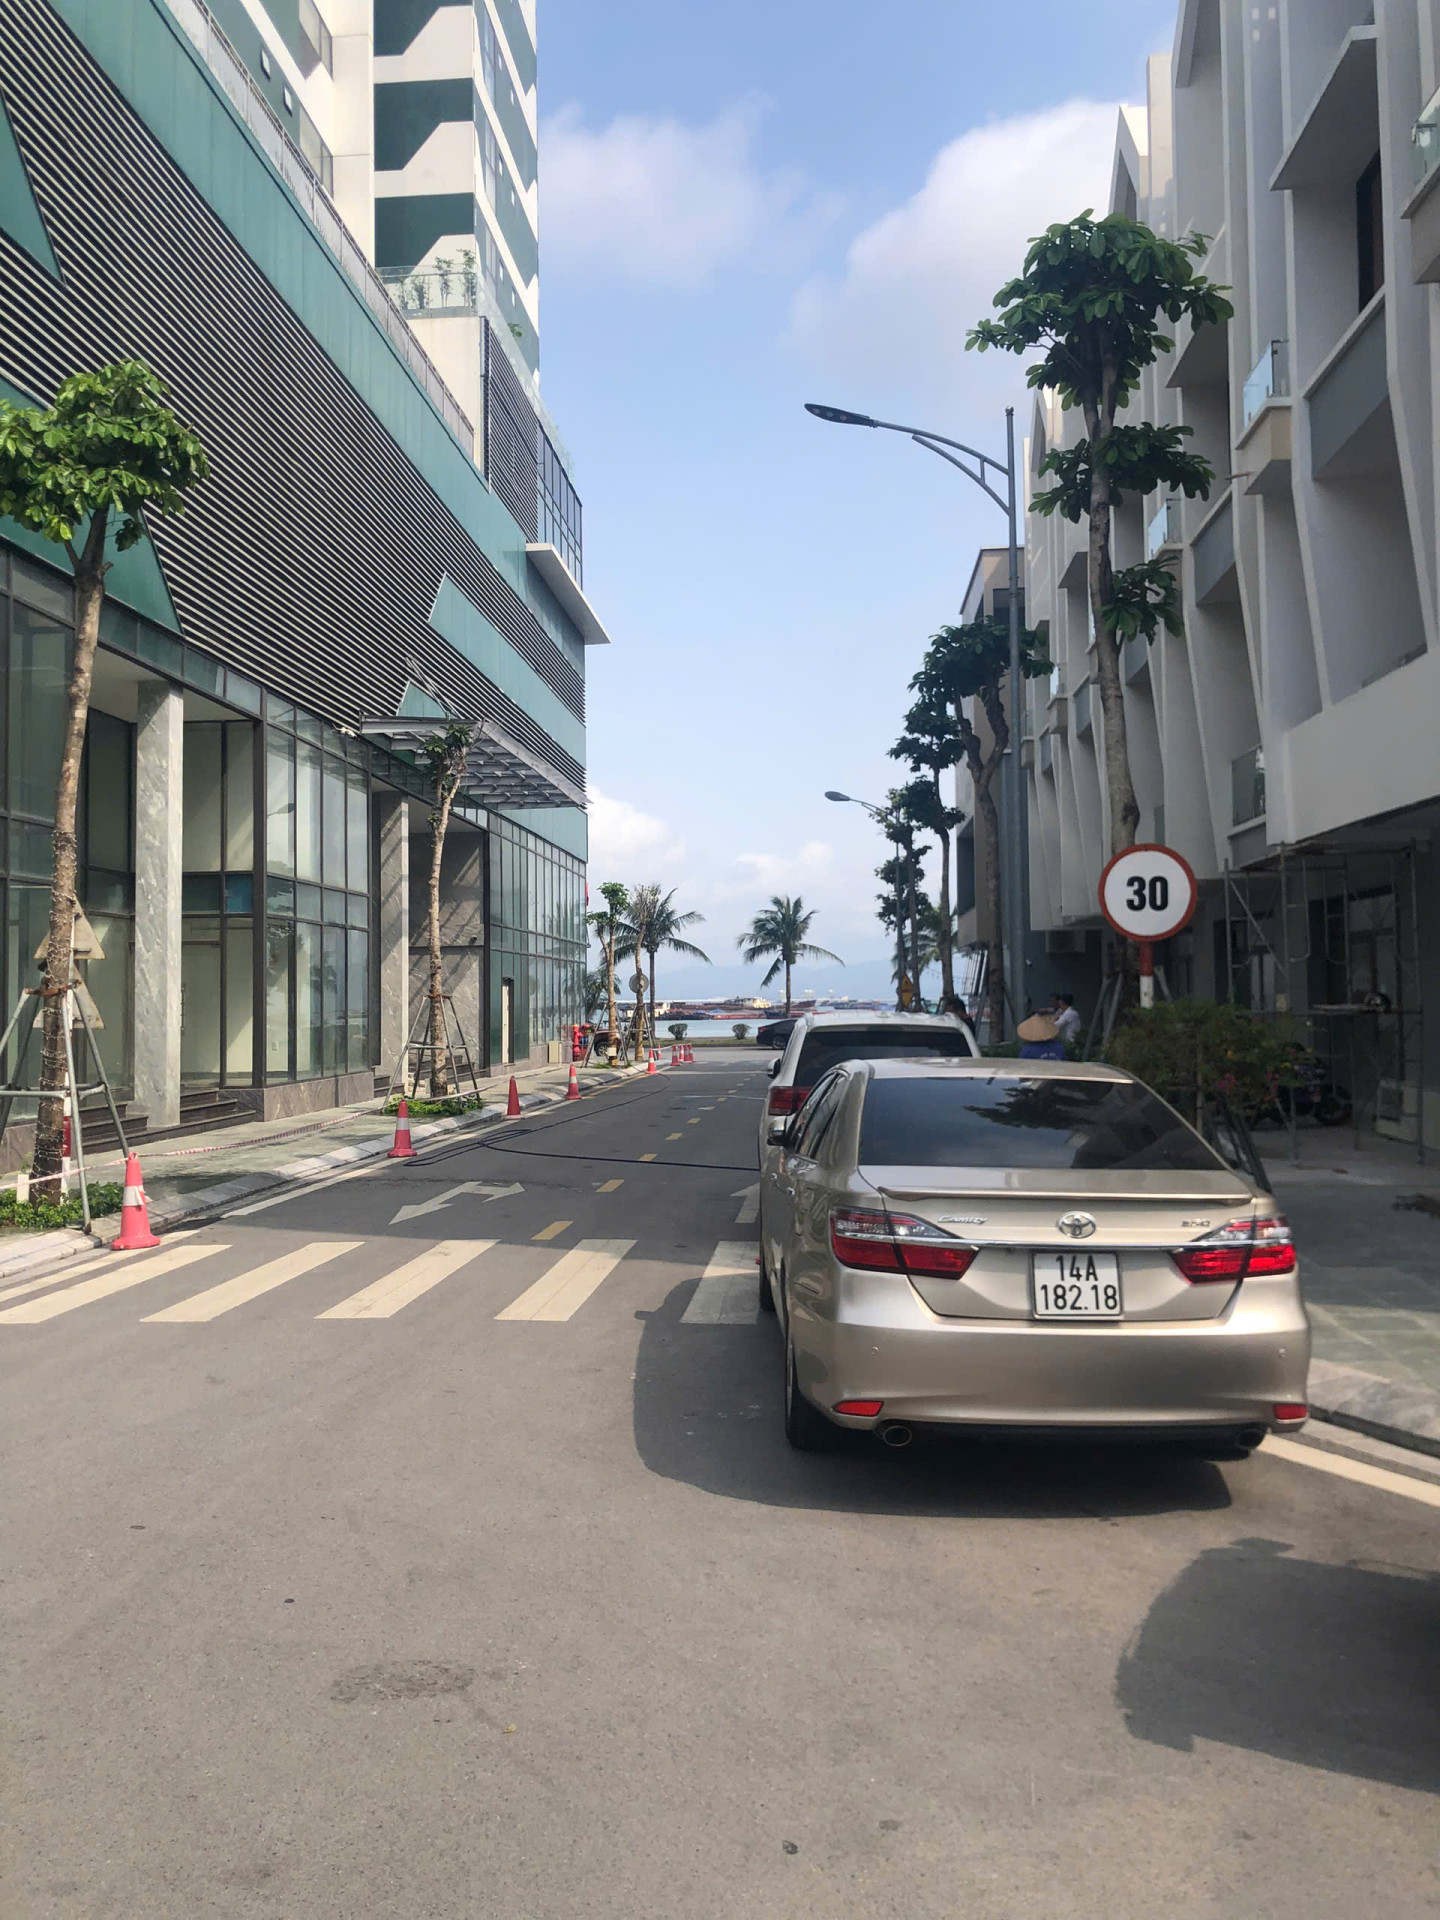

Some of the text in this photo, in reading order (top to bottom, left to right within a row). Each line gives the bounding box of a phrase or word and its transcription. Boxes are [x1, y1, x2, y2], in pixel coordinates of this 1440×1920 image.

[1126, 876, 1168, 911] 30
[1056, 1255, 1098, 1281] 14A
[1040, 1284, 1117, 1310] 182.18
